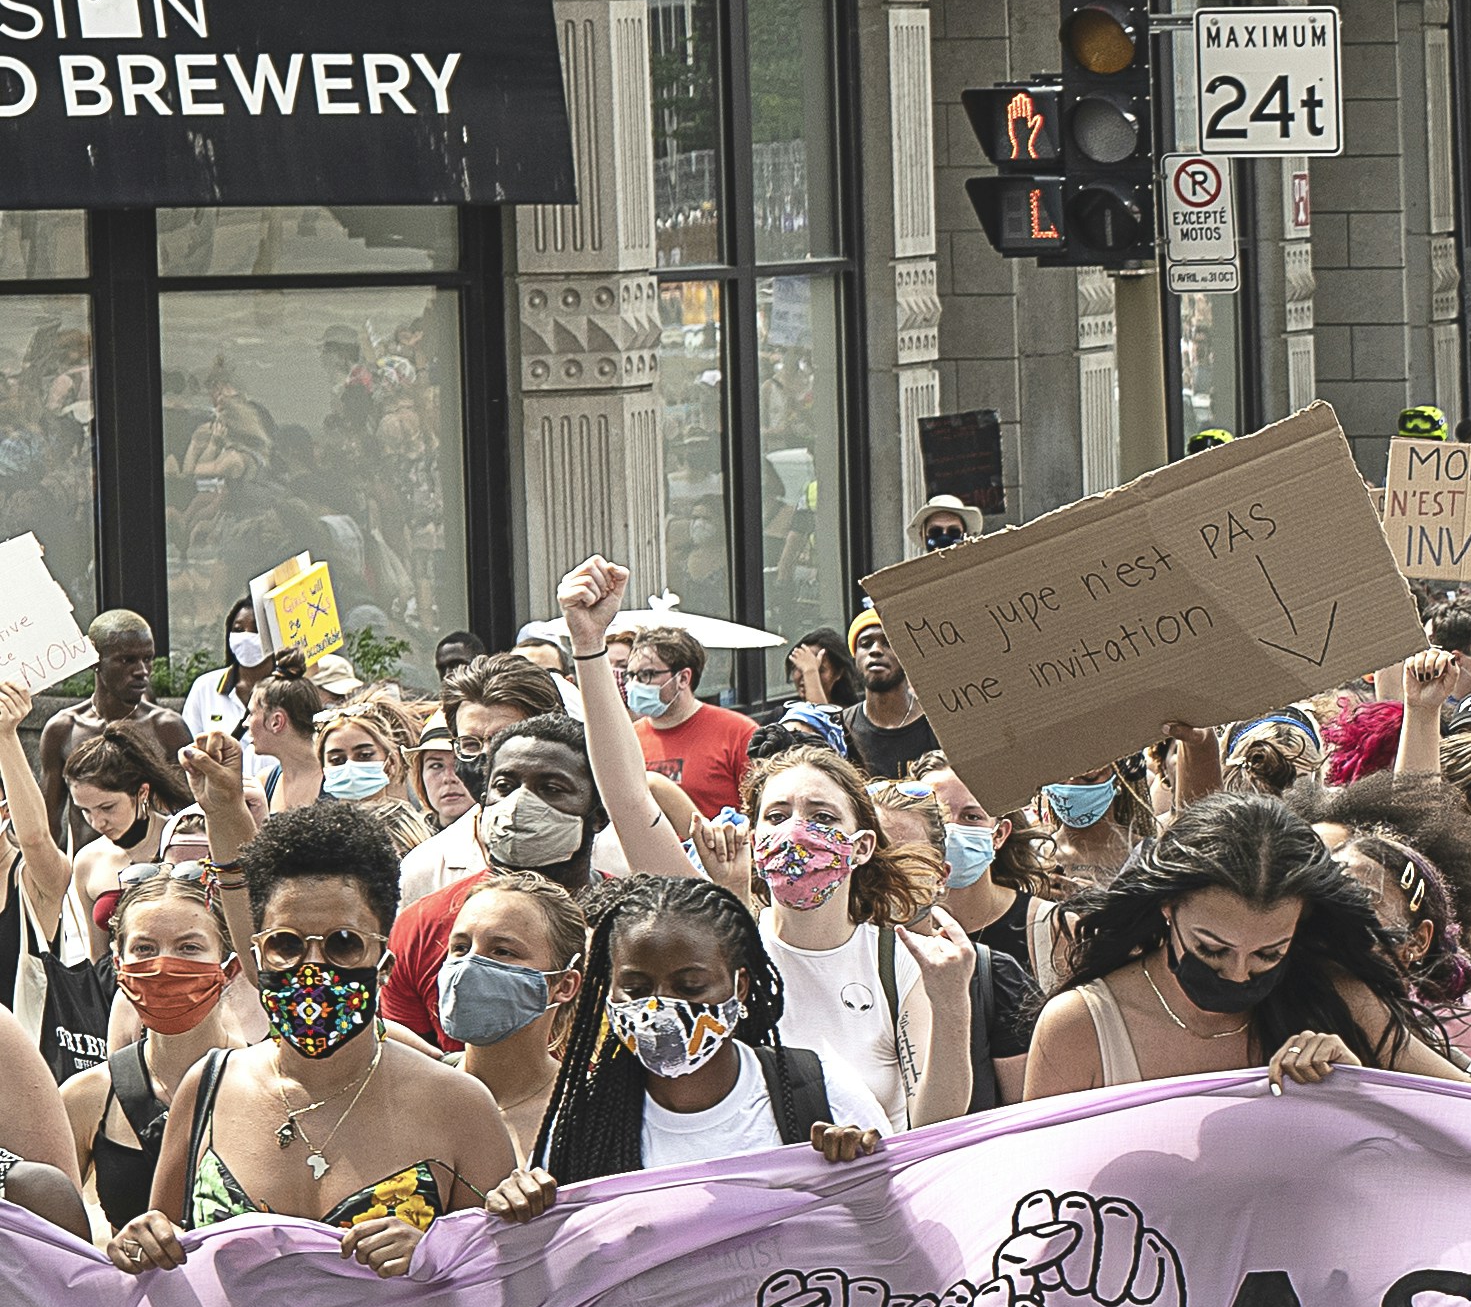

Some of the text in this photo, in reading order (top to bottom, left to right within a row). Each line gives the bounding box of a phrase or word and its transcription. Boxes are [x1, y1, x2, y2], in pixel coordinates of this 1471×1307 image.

[1205, 25, 1327, 48] MAXIMUM
[59, 53, 461, 116] BREWERY
[1204, 75, 1325, 140] 24t
[1172, 206, 1227, 226] EXCEPTÉ
[1180, 226, 1222, 242] MOTOS
[1176, 273, 1200, 284] AVRIL
[1218, 273, 1235, 283] OCT
[1390, 492, 1465, 520] N'EST
[904, 502, 1277, 659] Ma jupe n'est PAS
[20, 632, 87, 689] NOW
[938, 604, 1215, 716] une invitation
